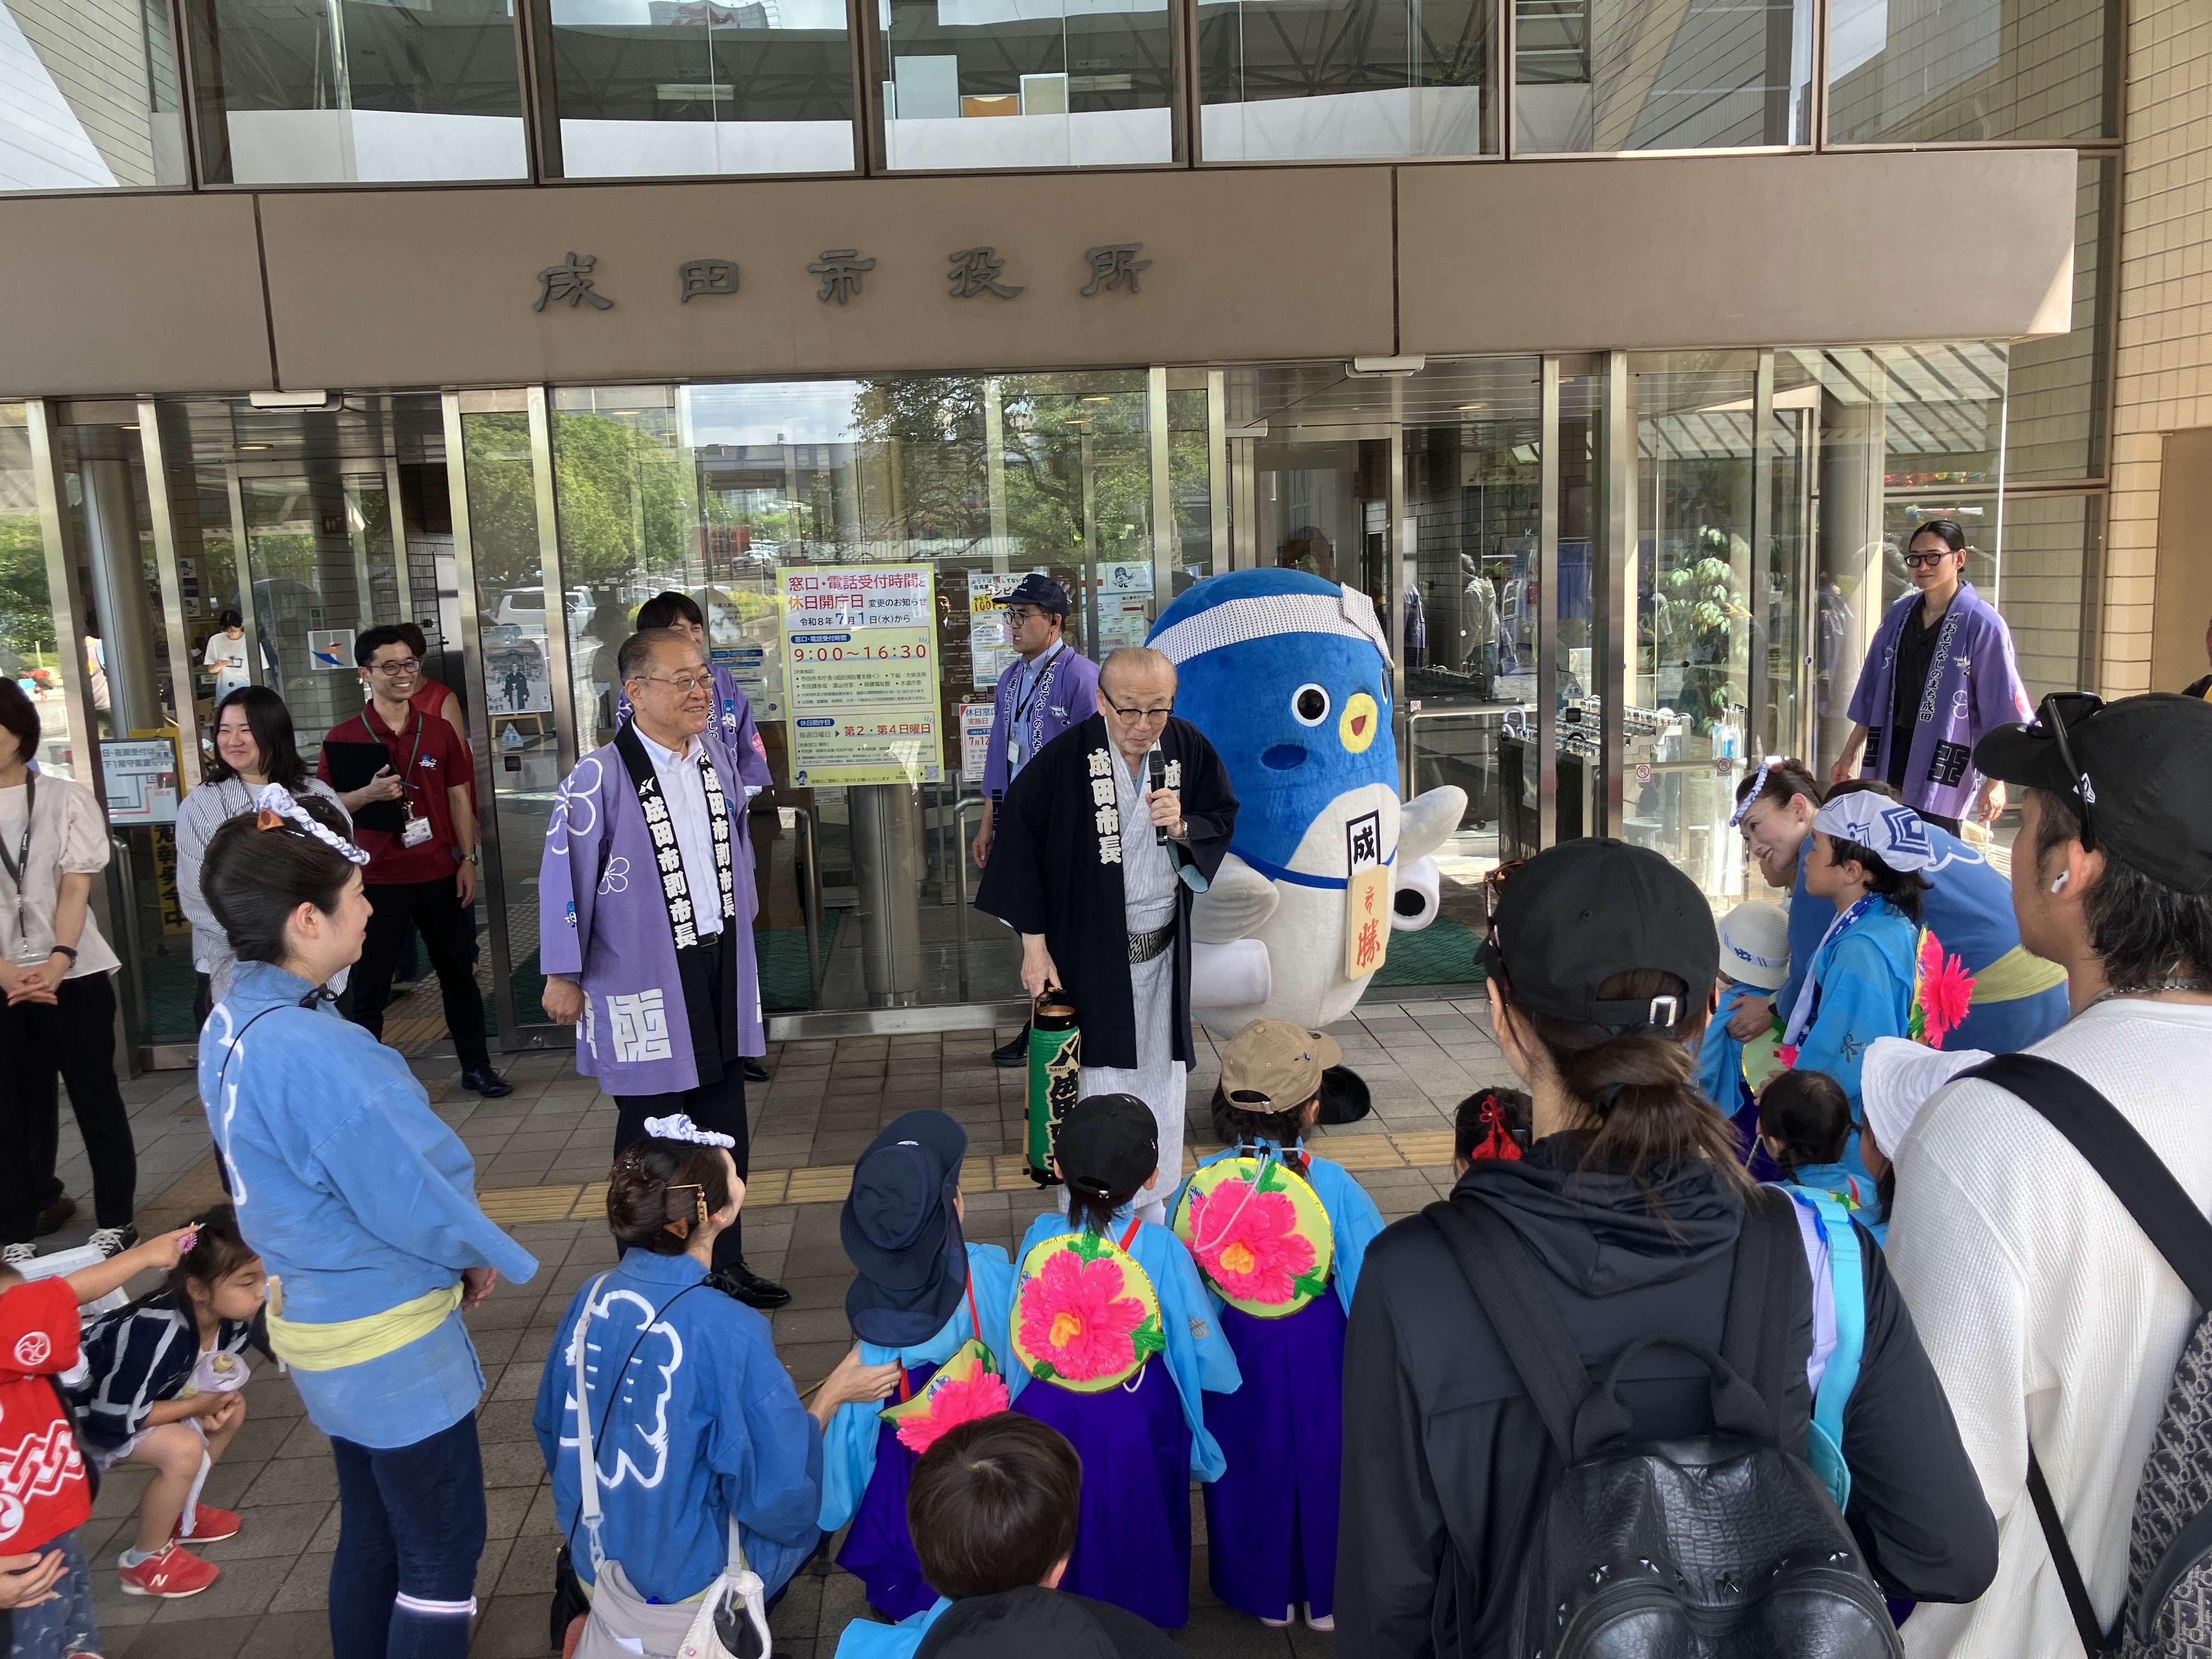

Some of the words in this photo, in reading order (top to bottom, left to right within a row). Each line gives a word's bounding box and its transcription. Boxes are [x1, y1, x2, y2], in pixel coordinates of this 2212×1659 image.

[533, 242, 1153, 312] 成田市役所
[788, 573, 926, 592] 窓口・電話受付時間と
[788, 594, 864, 611] 休日開庁日
[868, 597, 927, 608] 変更のお知らせ
[1920, 623, 1957, 723] おもてなしのまち成田
[844, 723, 932, 737] 第2・第4日曜日
[1031, 672, 1055, 759] おもてなしのまち
[703, 766, 735, 919] 成田市副市長
[1087, 747, 1122, 866] 成田市長
[1353, 825, 1375, 865] 成
[641, 795, 698, 951] 成田市副市長
